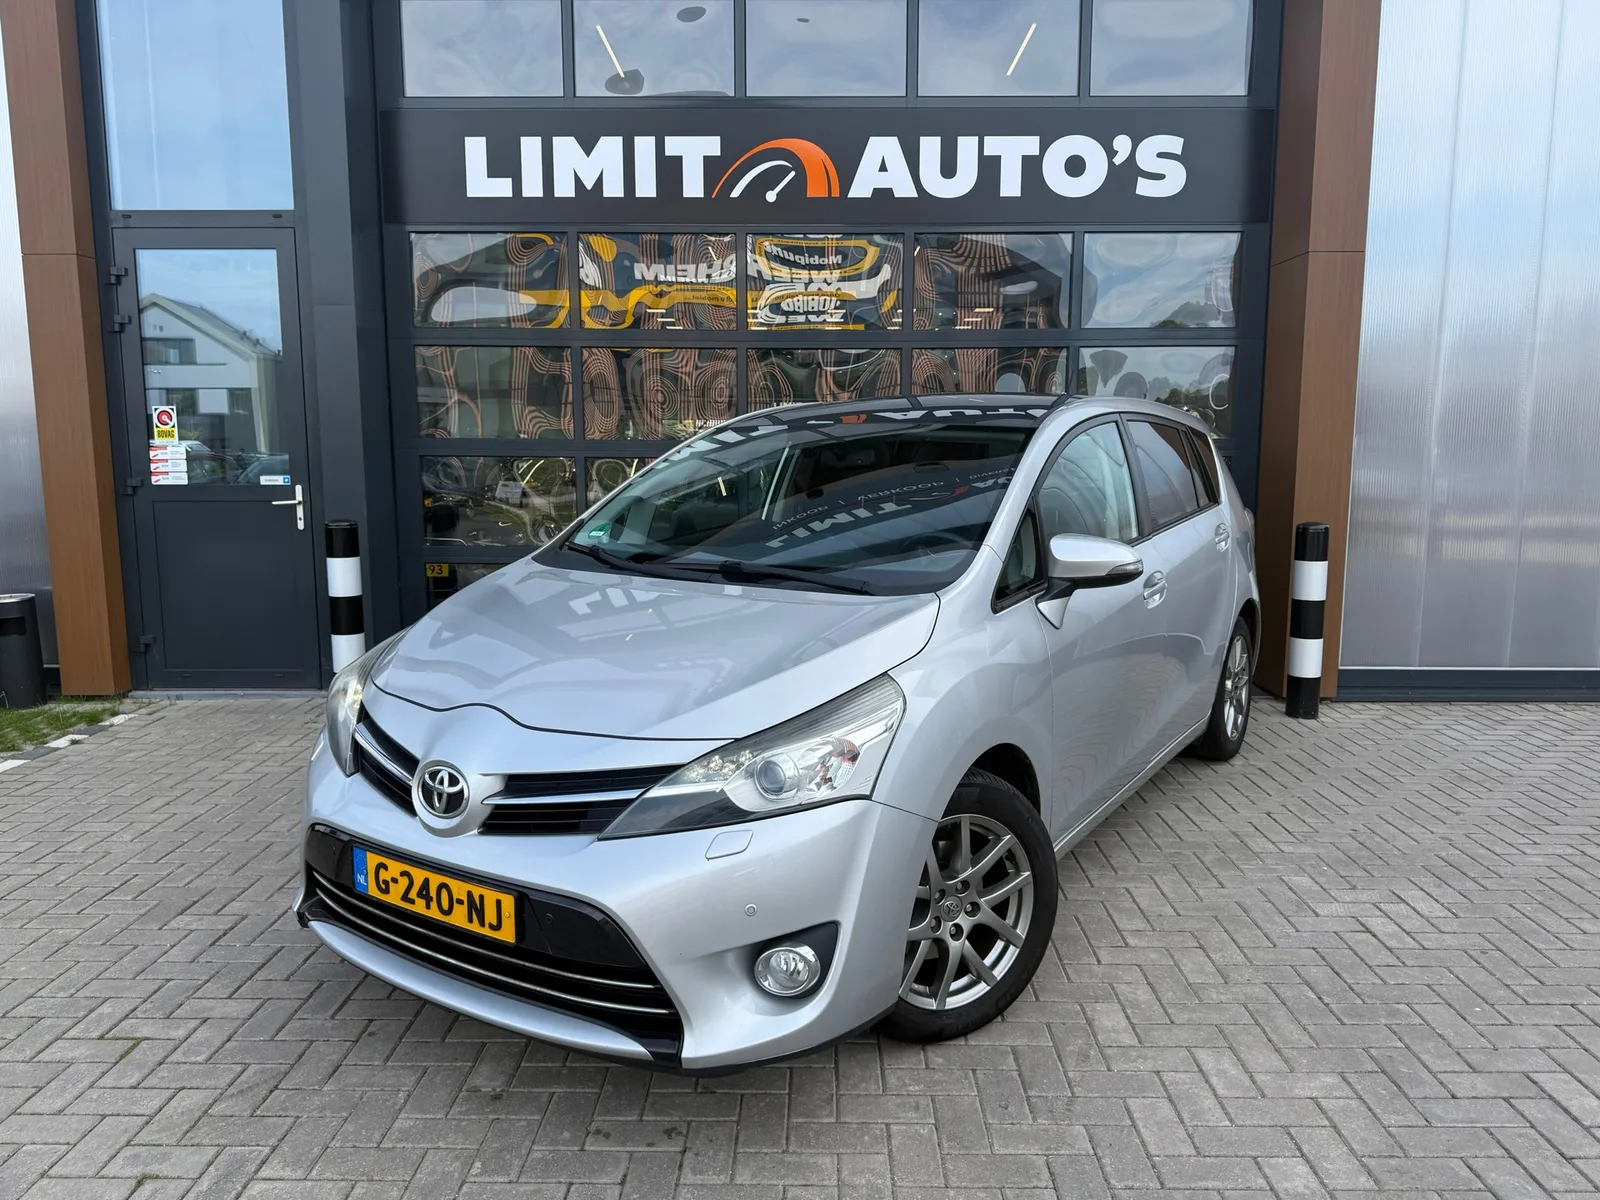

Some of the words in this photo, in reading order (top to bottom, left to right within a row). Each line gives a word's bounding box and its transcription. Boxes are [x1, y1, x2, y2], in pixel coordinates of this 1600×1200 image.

[465, 136, 721, 198] LIMIT
[848, 133, 1187, 199] AUTO'S
[157, 429, 175, 439] BOVAG
[357, 874, 367, 886] NL
[374, 862, 503, 932] G-240-NJ
